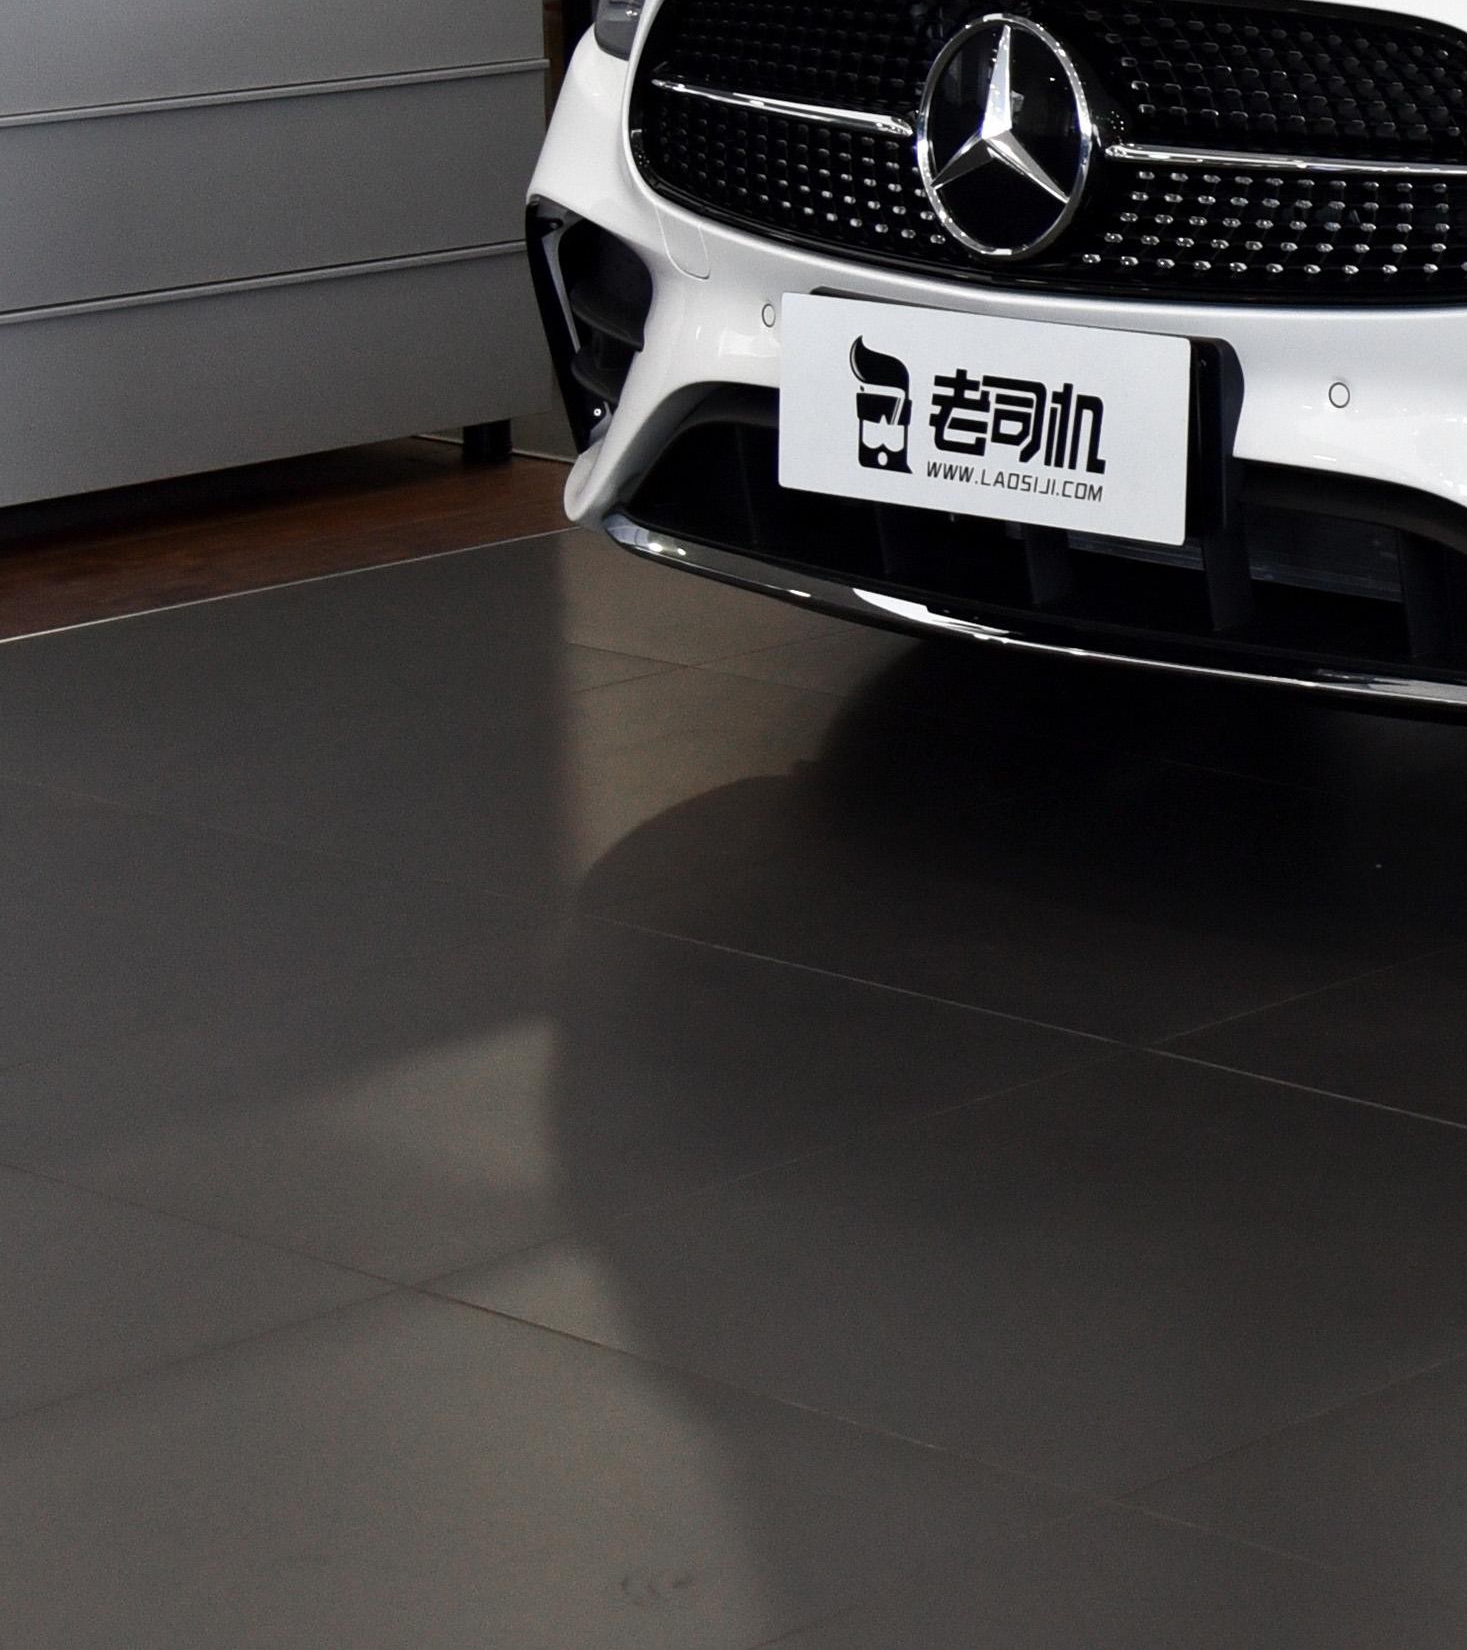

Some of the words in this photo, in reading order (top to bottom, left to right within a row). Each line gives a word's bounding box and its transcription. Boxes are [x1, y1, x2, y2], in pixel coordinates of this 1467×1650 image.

[927, 368, 1106, 476] 老司机
[926, 460, 1104, 504] WWW.LAOSIJI.COM
